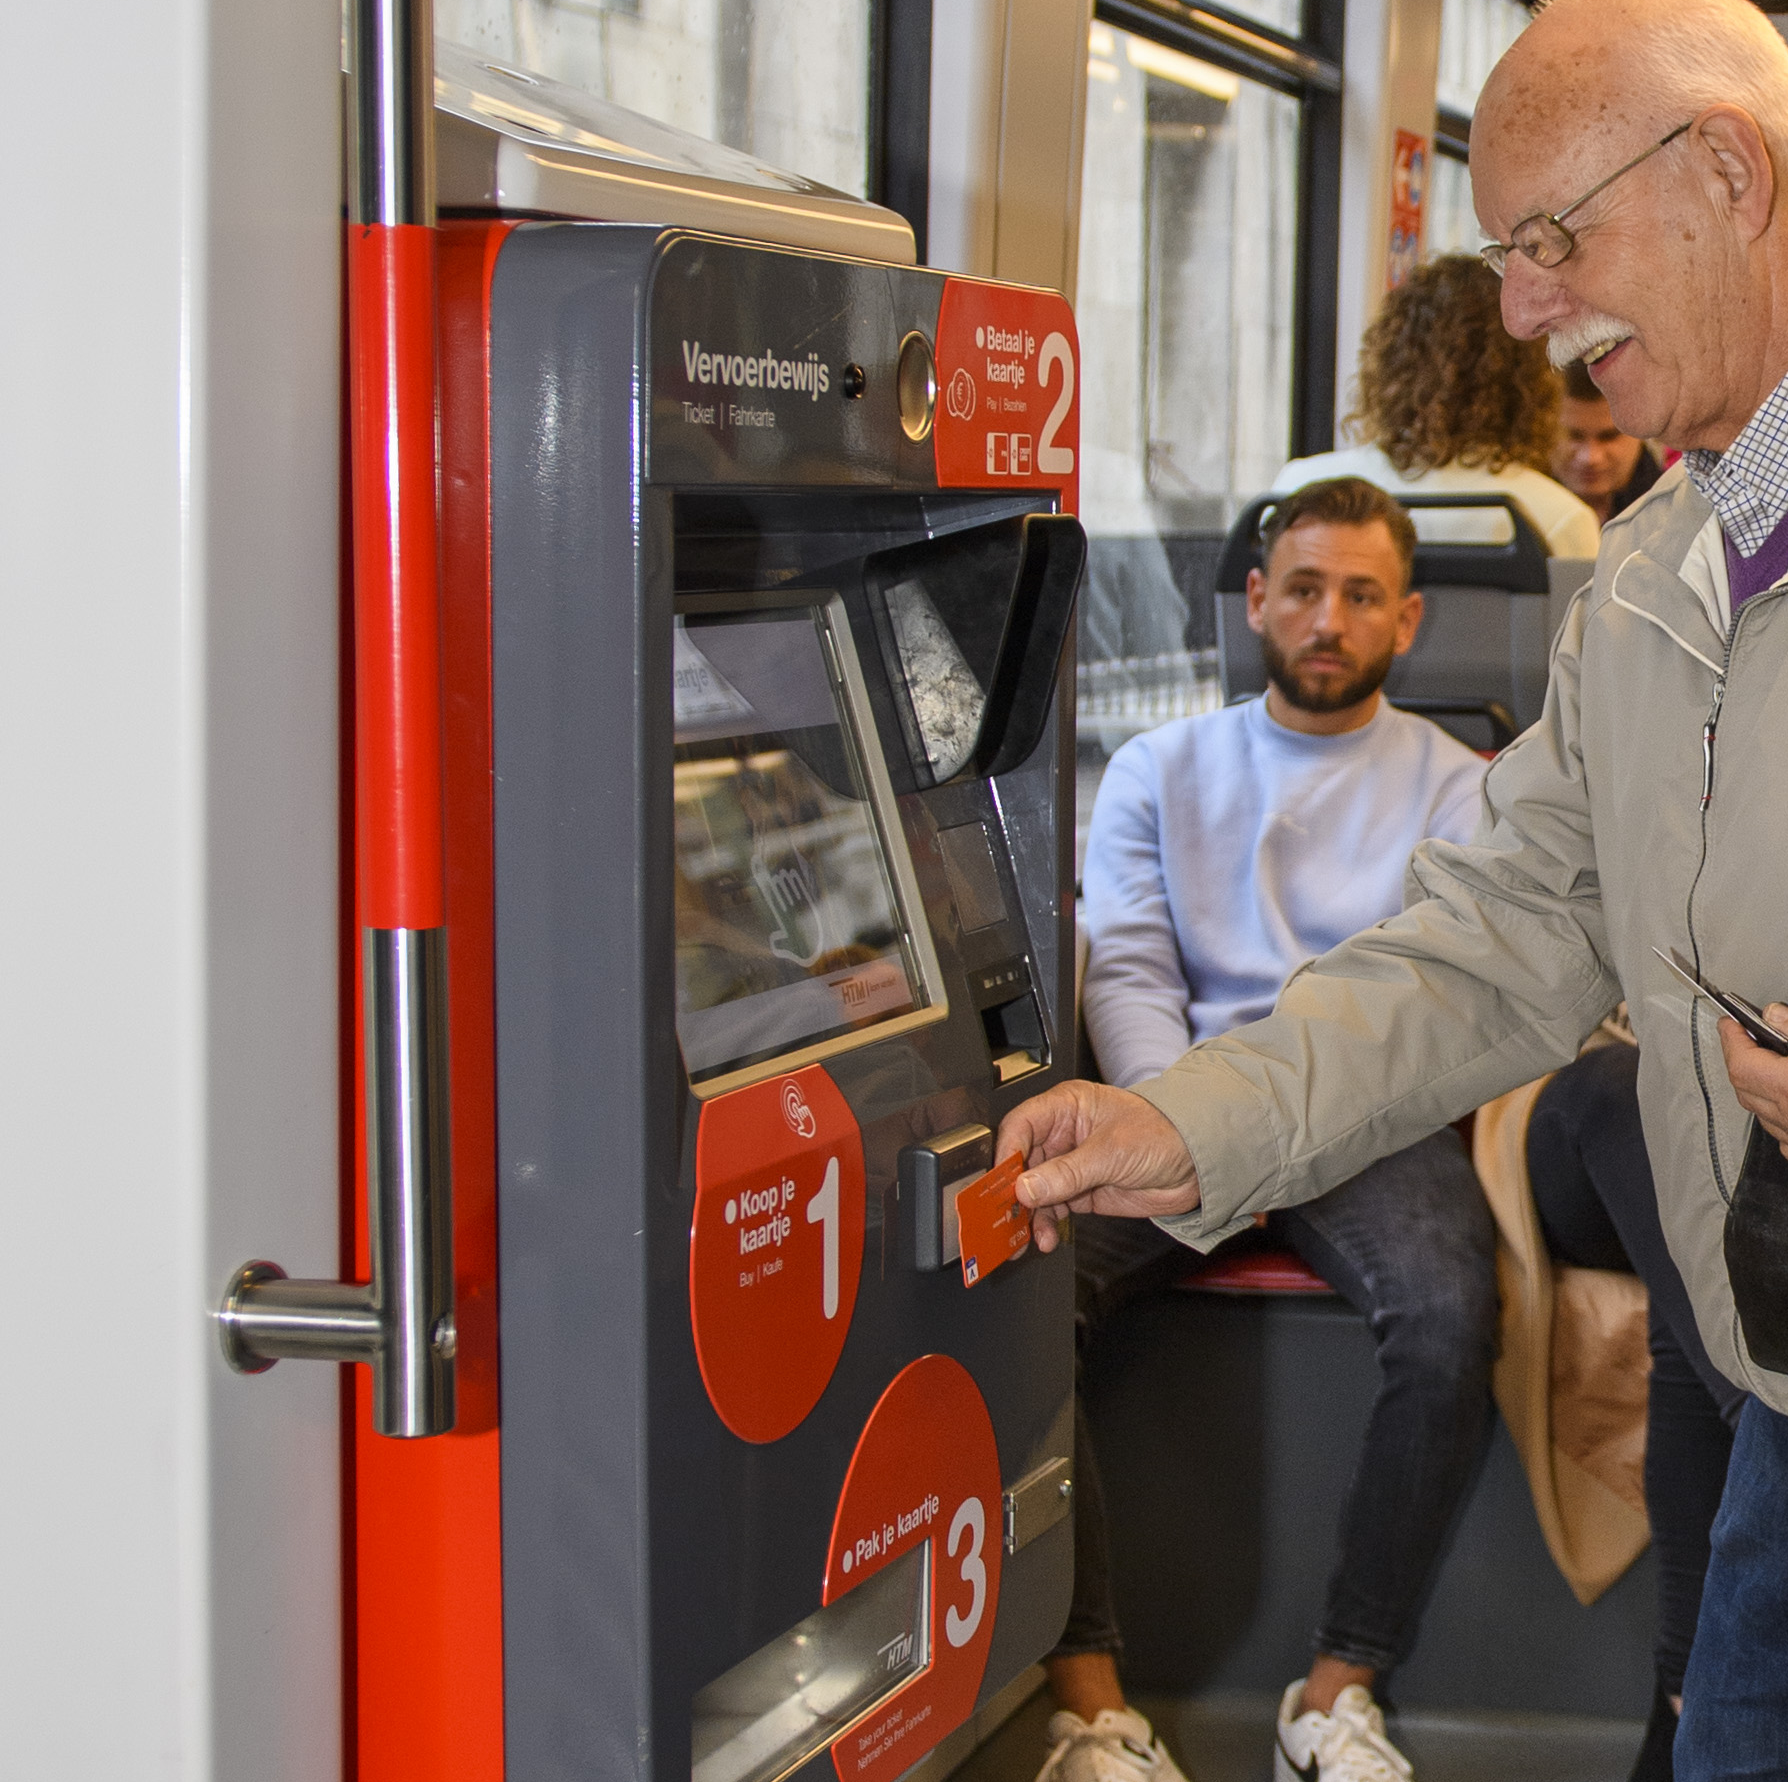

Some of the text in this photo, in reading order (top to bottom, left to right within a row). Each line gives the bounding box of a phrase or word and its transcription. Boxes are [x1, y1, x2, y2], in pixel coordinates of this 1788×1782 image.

[986, 324, 1036, 360] Betaal je
[682, 339, 830, 402] Vervoerbewijs
[986, 356, 1026, 390] kaartje
[682, 401, 776, 428] Ticket Fahrkarte
[986, 396, 997, 413] Pay
[1037, 331, 1075, 475] 2
[841, 981, 866, 1005] HTM
[740, 1175, 796, 1220] Koop je
[739, 1211, 792, 1255] kaartje
[806, 1156, 840, 1320] 1
[739, 1271, 755, 1288] Buy
[855, 1492, 940, 1567] Pak je kaartje
[945, 1496, 987, 1648] 3
[886, 1633, 914, 1671] HTM
[872, 1723, 886, 1743] your
[883, 1735, 894, 1751] Sie
